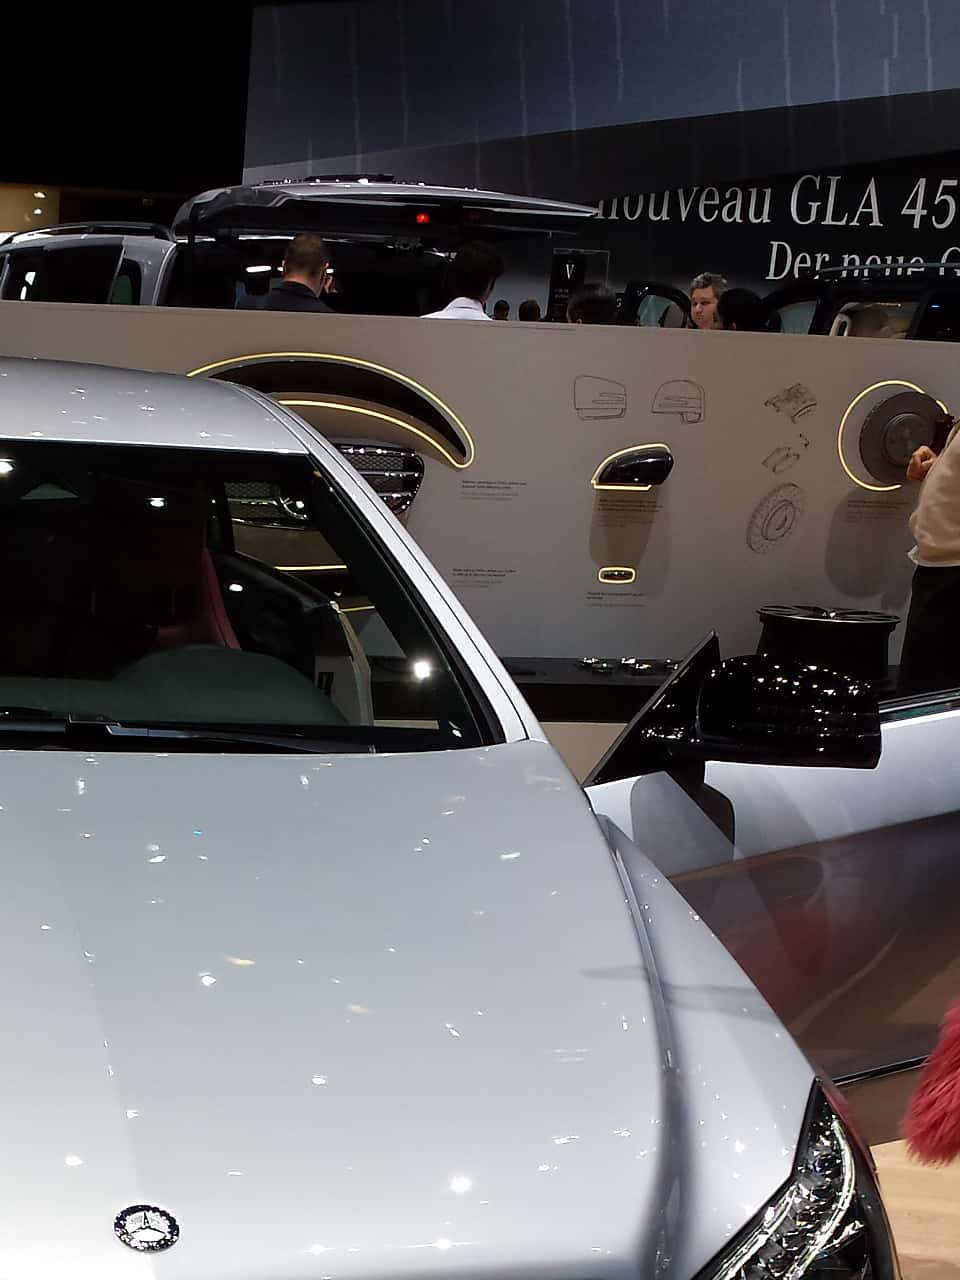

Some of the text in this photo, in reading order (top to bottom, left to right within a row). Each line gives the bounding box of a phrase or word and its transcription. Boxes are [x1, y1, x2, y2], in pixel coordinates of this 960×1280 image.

[790, 174, 884, 228] GLA
[901, 177, 959, 230] 45
[565, 263, 575, 280] V
[765, 240, 831, 281] Der
